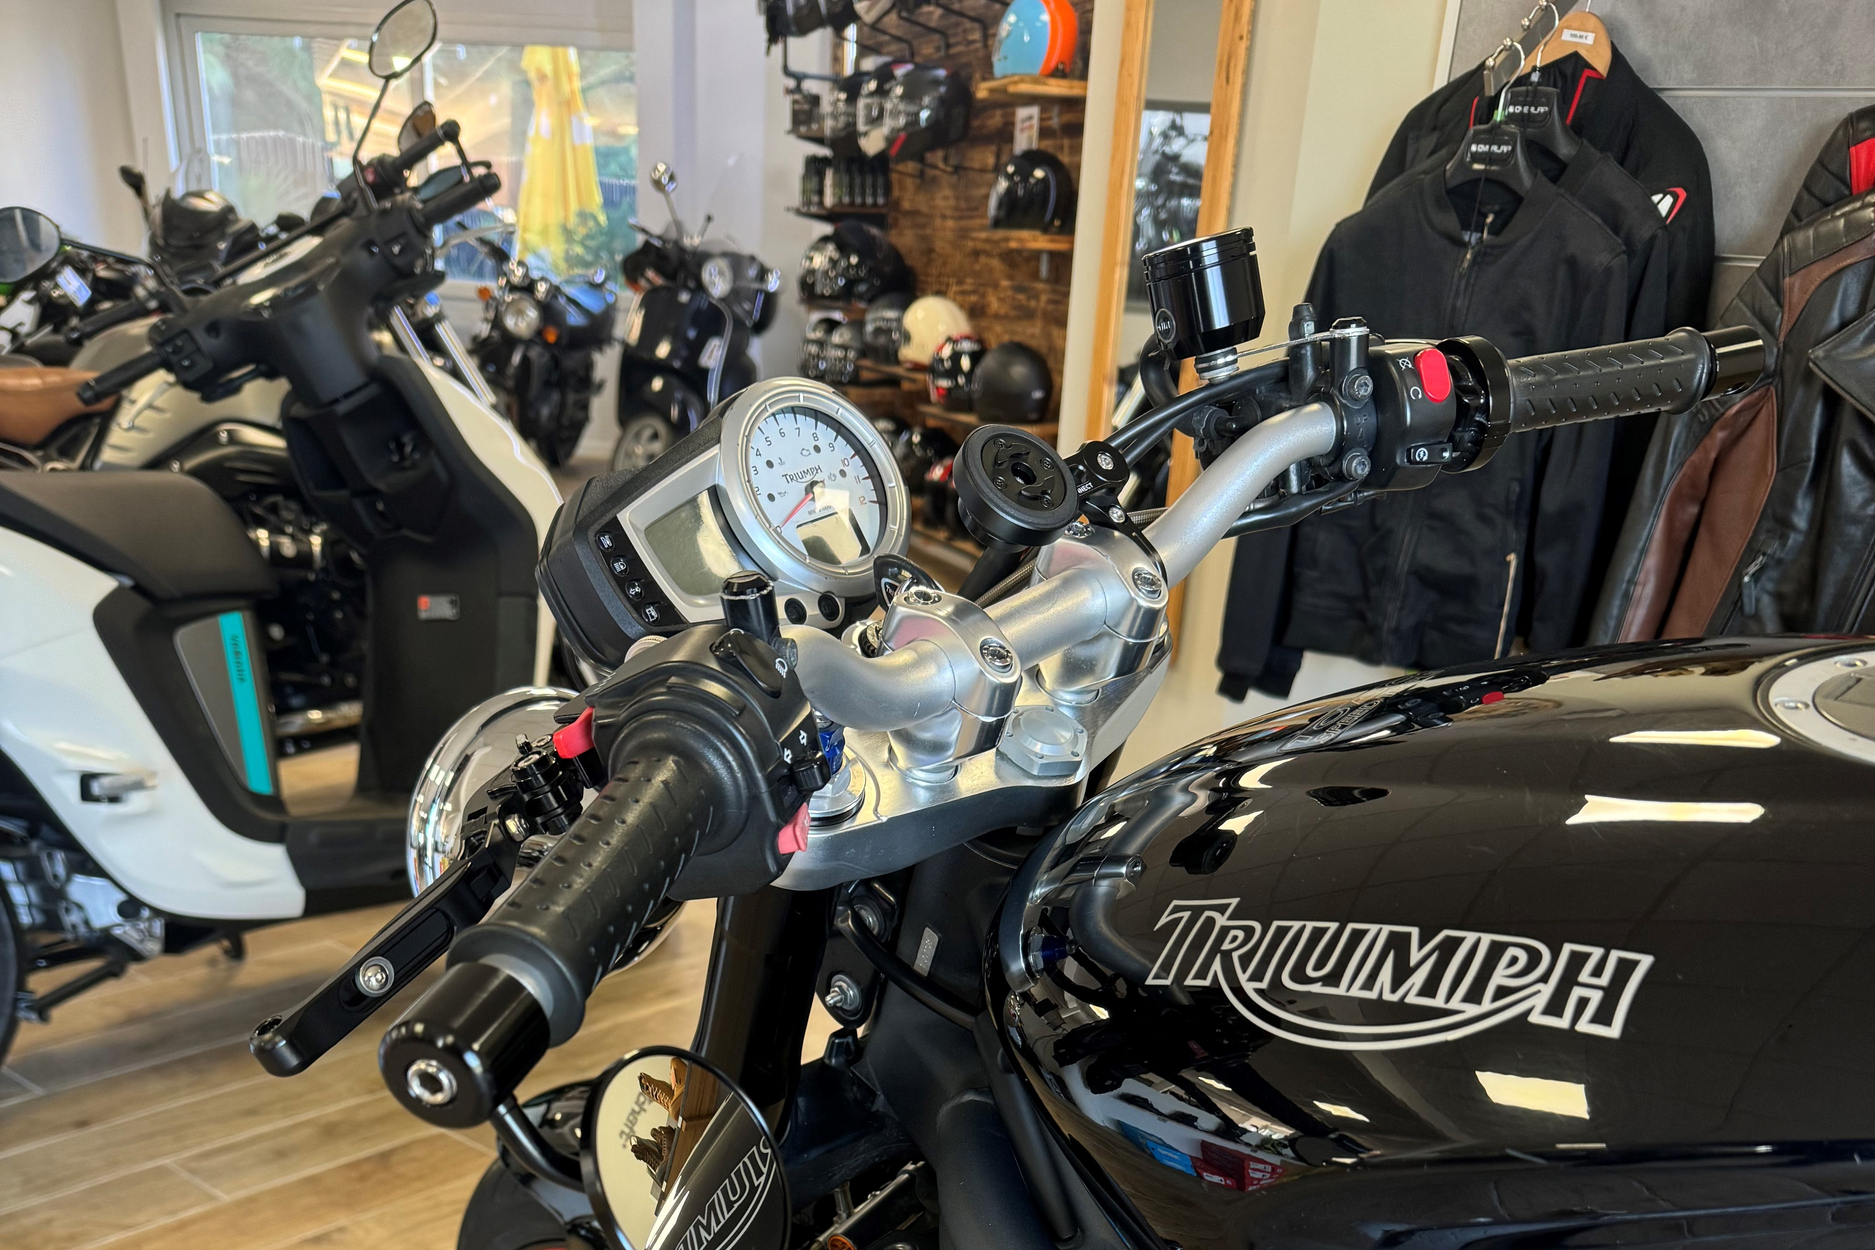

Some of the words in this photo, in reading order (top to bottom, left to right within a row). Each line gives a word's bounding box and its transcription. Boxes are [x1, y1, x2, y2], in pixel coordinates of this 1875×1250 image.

[779, 428, 785, 438] 6
[812, 432, 819, 442] 8
[765, 437, 772, 446] 5
[829, 443, 835, 452] 9
[755, 448, 762, 458] 4
[841, 458, 850, 468] 10
[752, 466, 759, 475] 3
[782, 465, 822, 483] TRIUMPH
[854, 475, 861, 484] 11
[858, 496, 867, 506] 12
[1144, 897, 1655, 1051] TRIUMPH
